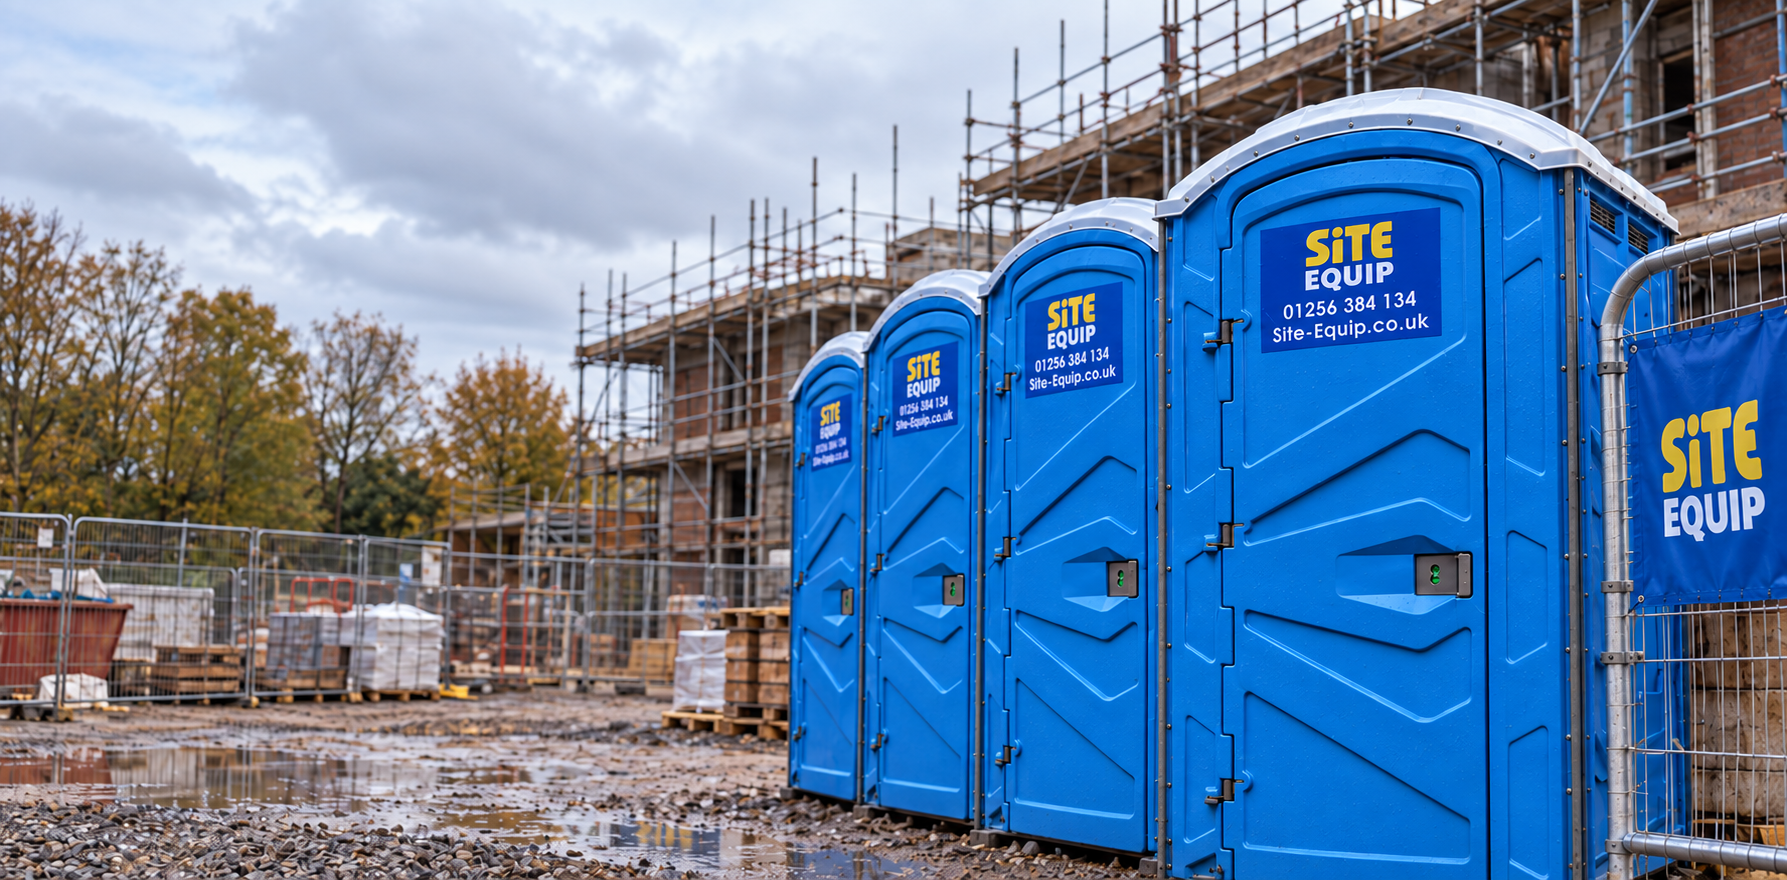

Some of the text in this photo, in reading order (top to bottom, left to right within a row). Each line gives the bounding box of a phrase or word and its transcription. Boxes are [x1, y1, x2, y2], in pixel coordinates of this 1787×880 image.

[1305, 220, 1393, 267] SiTE
[1305, 261, 1394, 291] EQUIP
[1047, 293, 1096, 332] SiTE
[1283, 290, 1417, 319] 01256 384 134
[1047, 324, 1096, 350] EQUIP
[1272, 313, 1429, 343] Site-Equip.co.uk
[907, 350, 940, 382] SiTE
[1035, 346, 1110, 373] 01256 384 134
[907, 376, 941, 398] EQUIP
[1029, 364, 1116, 391] Site-Equip.co.uk
[935, 395, 949, 409] 134
[1661, 399, 1763, 493] SiTE
[1663, 486, 1766, 542] EQUIP
